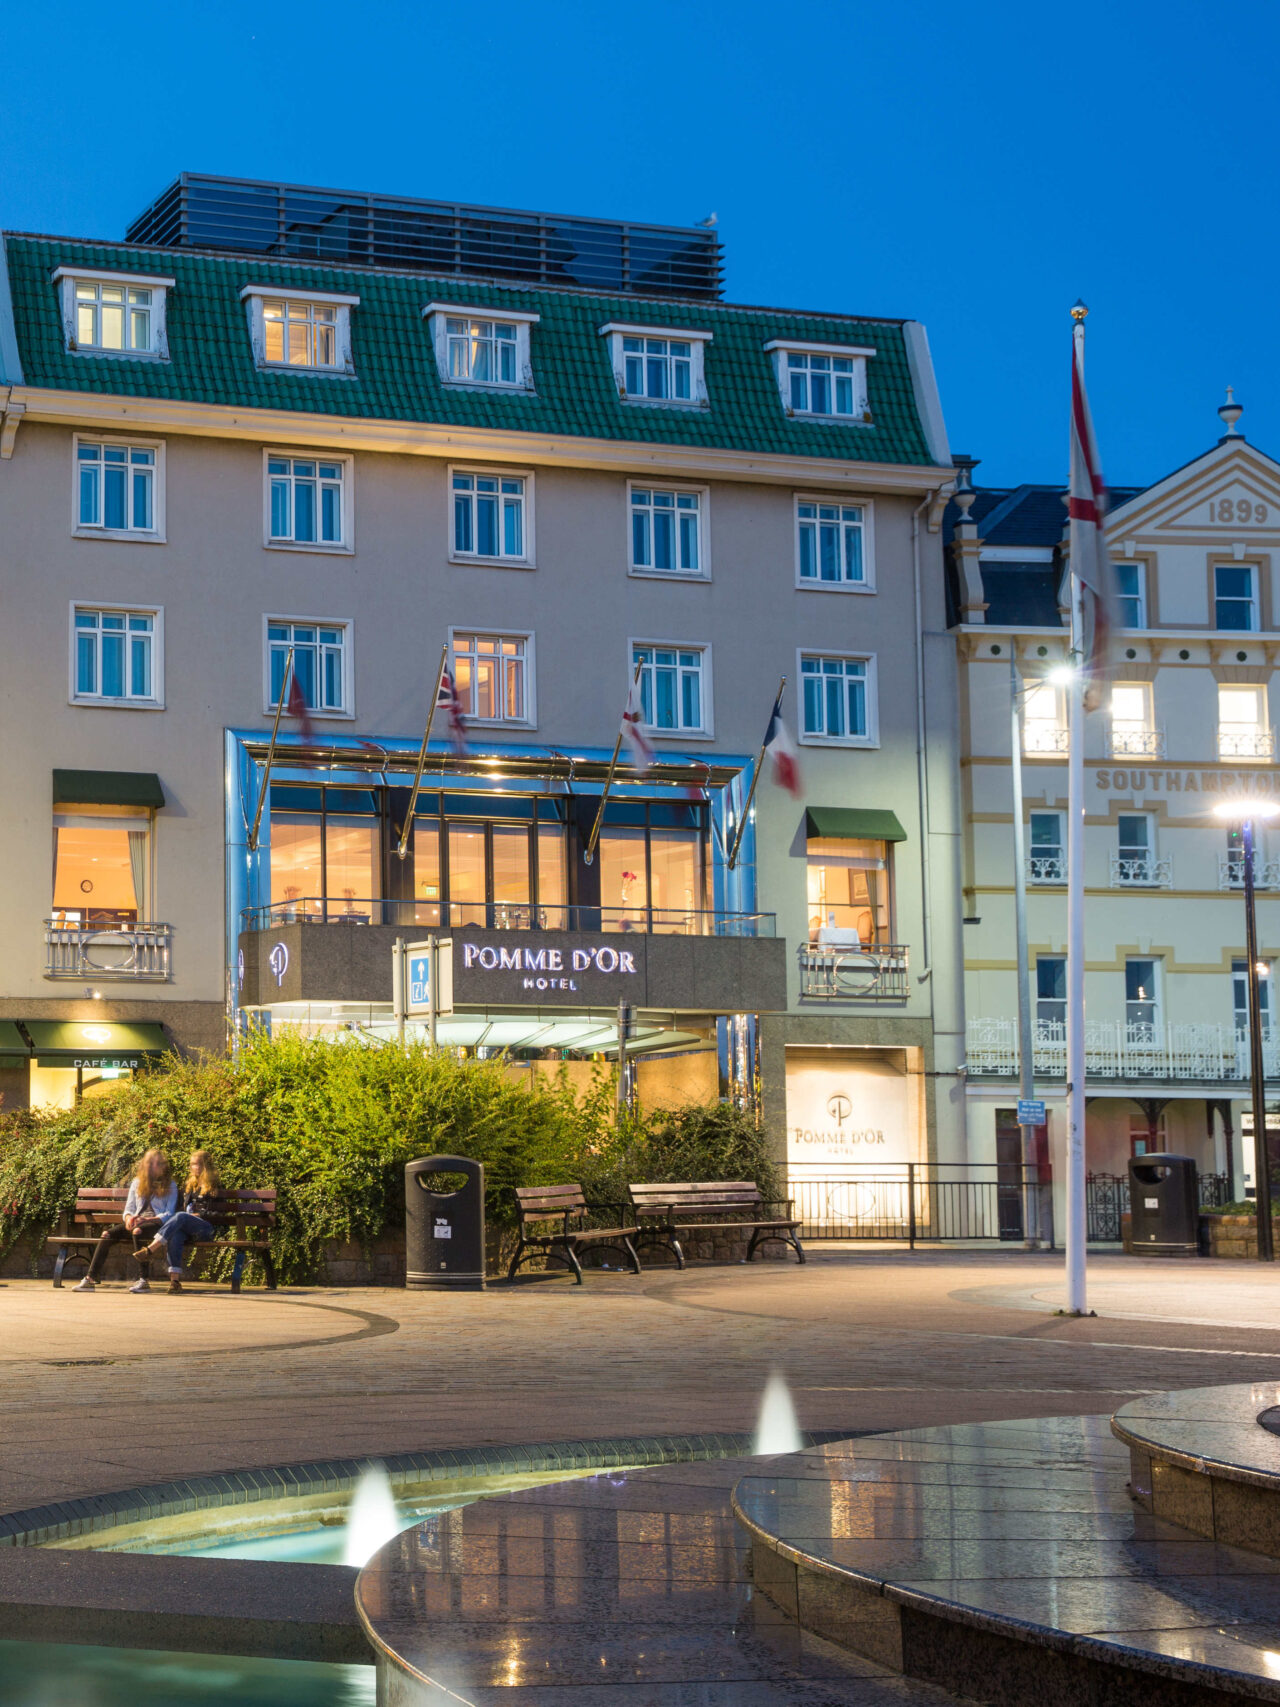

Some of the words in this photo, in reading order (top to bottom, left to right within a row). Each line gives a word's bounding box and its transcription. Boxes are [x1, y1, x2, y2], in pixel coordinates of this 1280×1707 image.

[1209, 498, 1268, 524] 1899
[463, 943, 564, 973] POMME
[523, 977, 579, 992] HOTEL
[73, 1058, 107, 1068] CAFÉ
[112, 1060, 138, 1068] BAR
[794, 1127, 847, 1145] POMME
